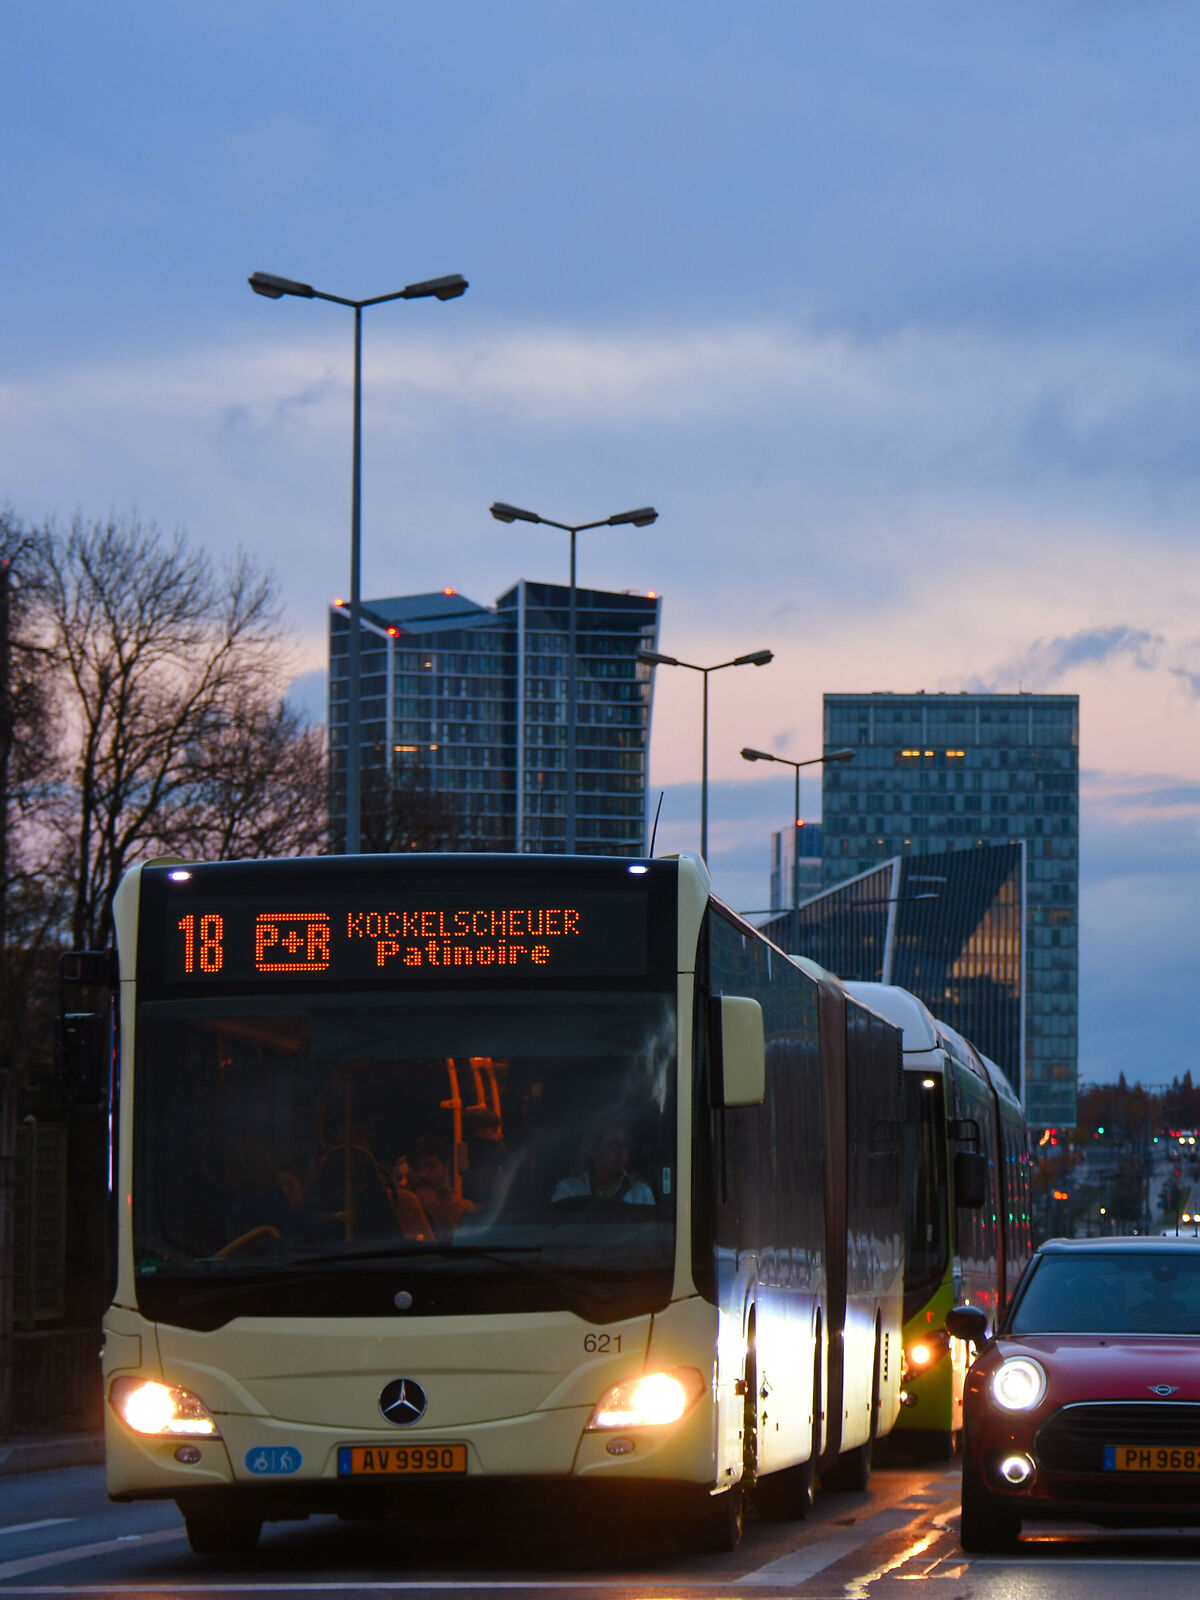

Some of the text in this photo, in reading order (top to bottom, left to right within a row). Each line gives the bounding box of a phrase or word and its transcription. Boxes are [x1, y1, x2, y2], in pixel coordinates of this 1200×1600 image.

[347, 909, 580, 938] KOCKELSCHEUER
[177, 914, 224, 973] 18
[255, 923, 331, 961] P+R
[376, 938, 551, 967] Patinoire
[583, 1333, 622, 1353] 621
[362, 1448, 454, 1471] AV 9990
[1125, 1449, 1152, 1469] PH
